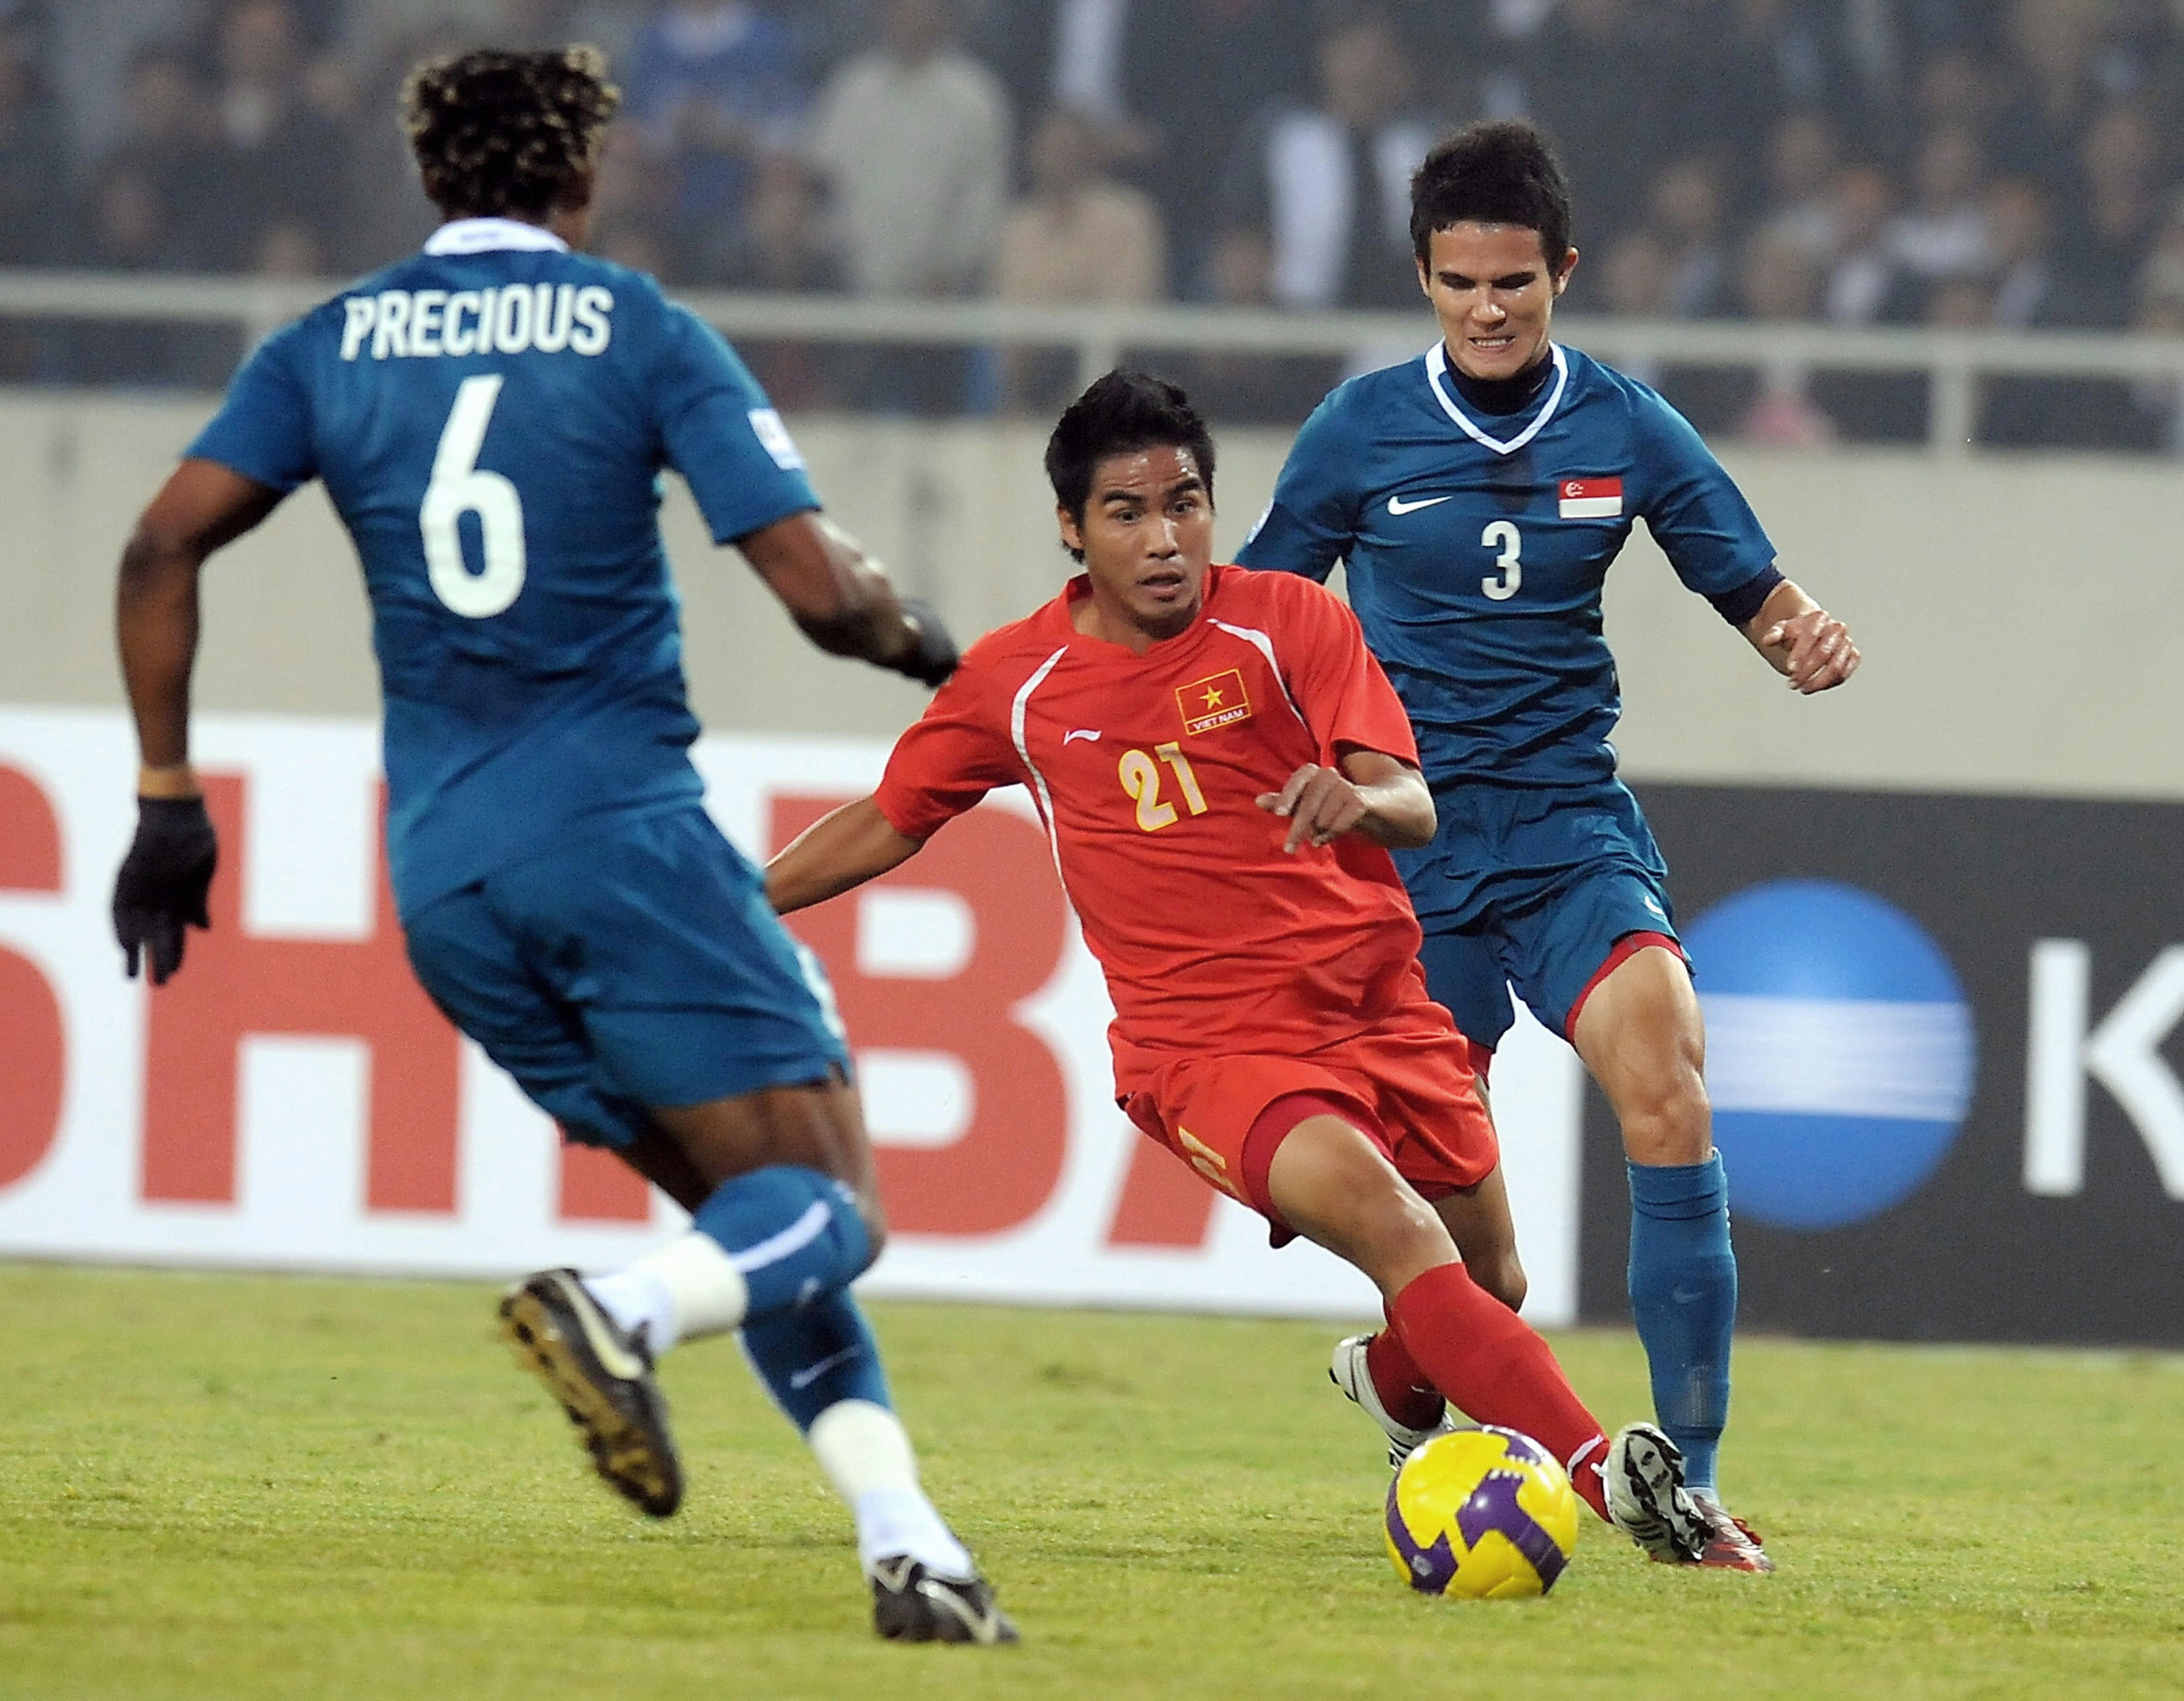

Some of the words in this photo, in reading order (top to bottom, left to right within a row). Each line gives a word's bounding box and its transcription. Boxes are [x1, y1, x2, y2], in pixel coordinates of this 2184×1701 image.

[340, 283, 614, 360] PRECIOUS
[419, 373, 526, 619] 6
[1481, 520, 1522, 600] 3
[1192, 717, 1218, 731] VIET
[1218, 709, 1244, 723] NAM
[1119, 741, 1208, 831] 21
[2023, 938, 2184, 1203] K
